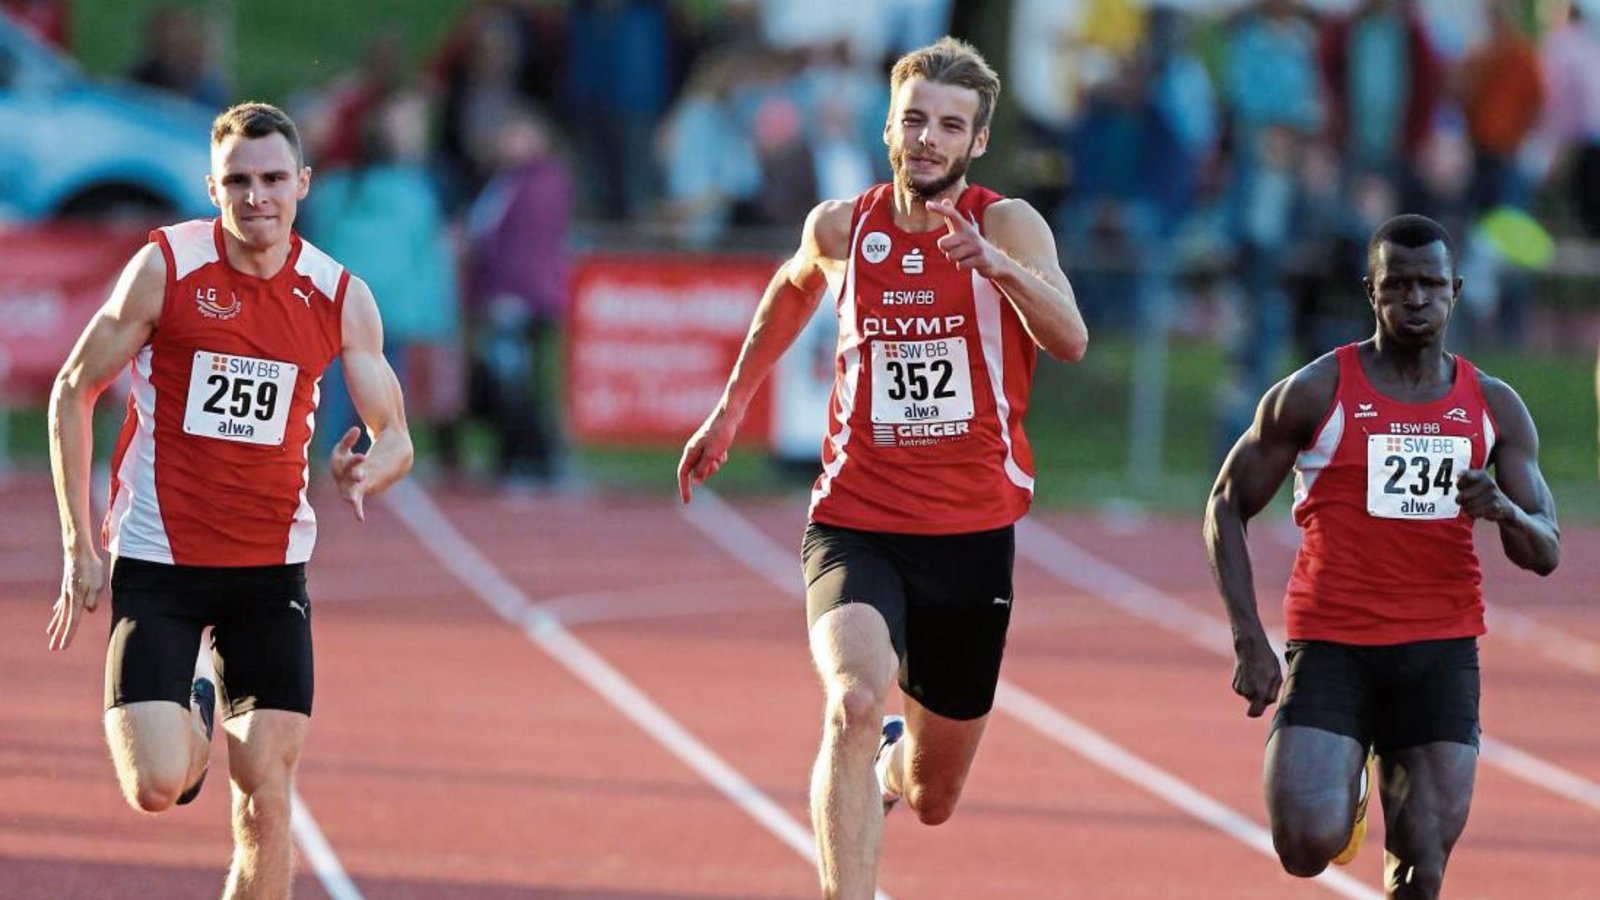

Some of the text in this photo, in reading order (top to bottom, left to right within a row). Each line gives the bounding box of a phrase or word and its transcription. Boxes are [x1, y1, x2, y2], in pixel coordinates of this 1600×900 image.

[863, 315, 965, 336] OLYMP
[886, 359, 956, 401] 352
[202, 374, 278, 421] 259
[904, 403, 939, 418] alwa
[217, 419, 255, 436] alwa
[897, 421, 970, 437] GEIGER
[1384, 455, 1454, 496] 234
[1401, 498, 1436, 513] alwa
